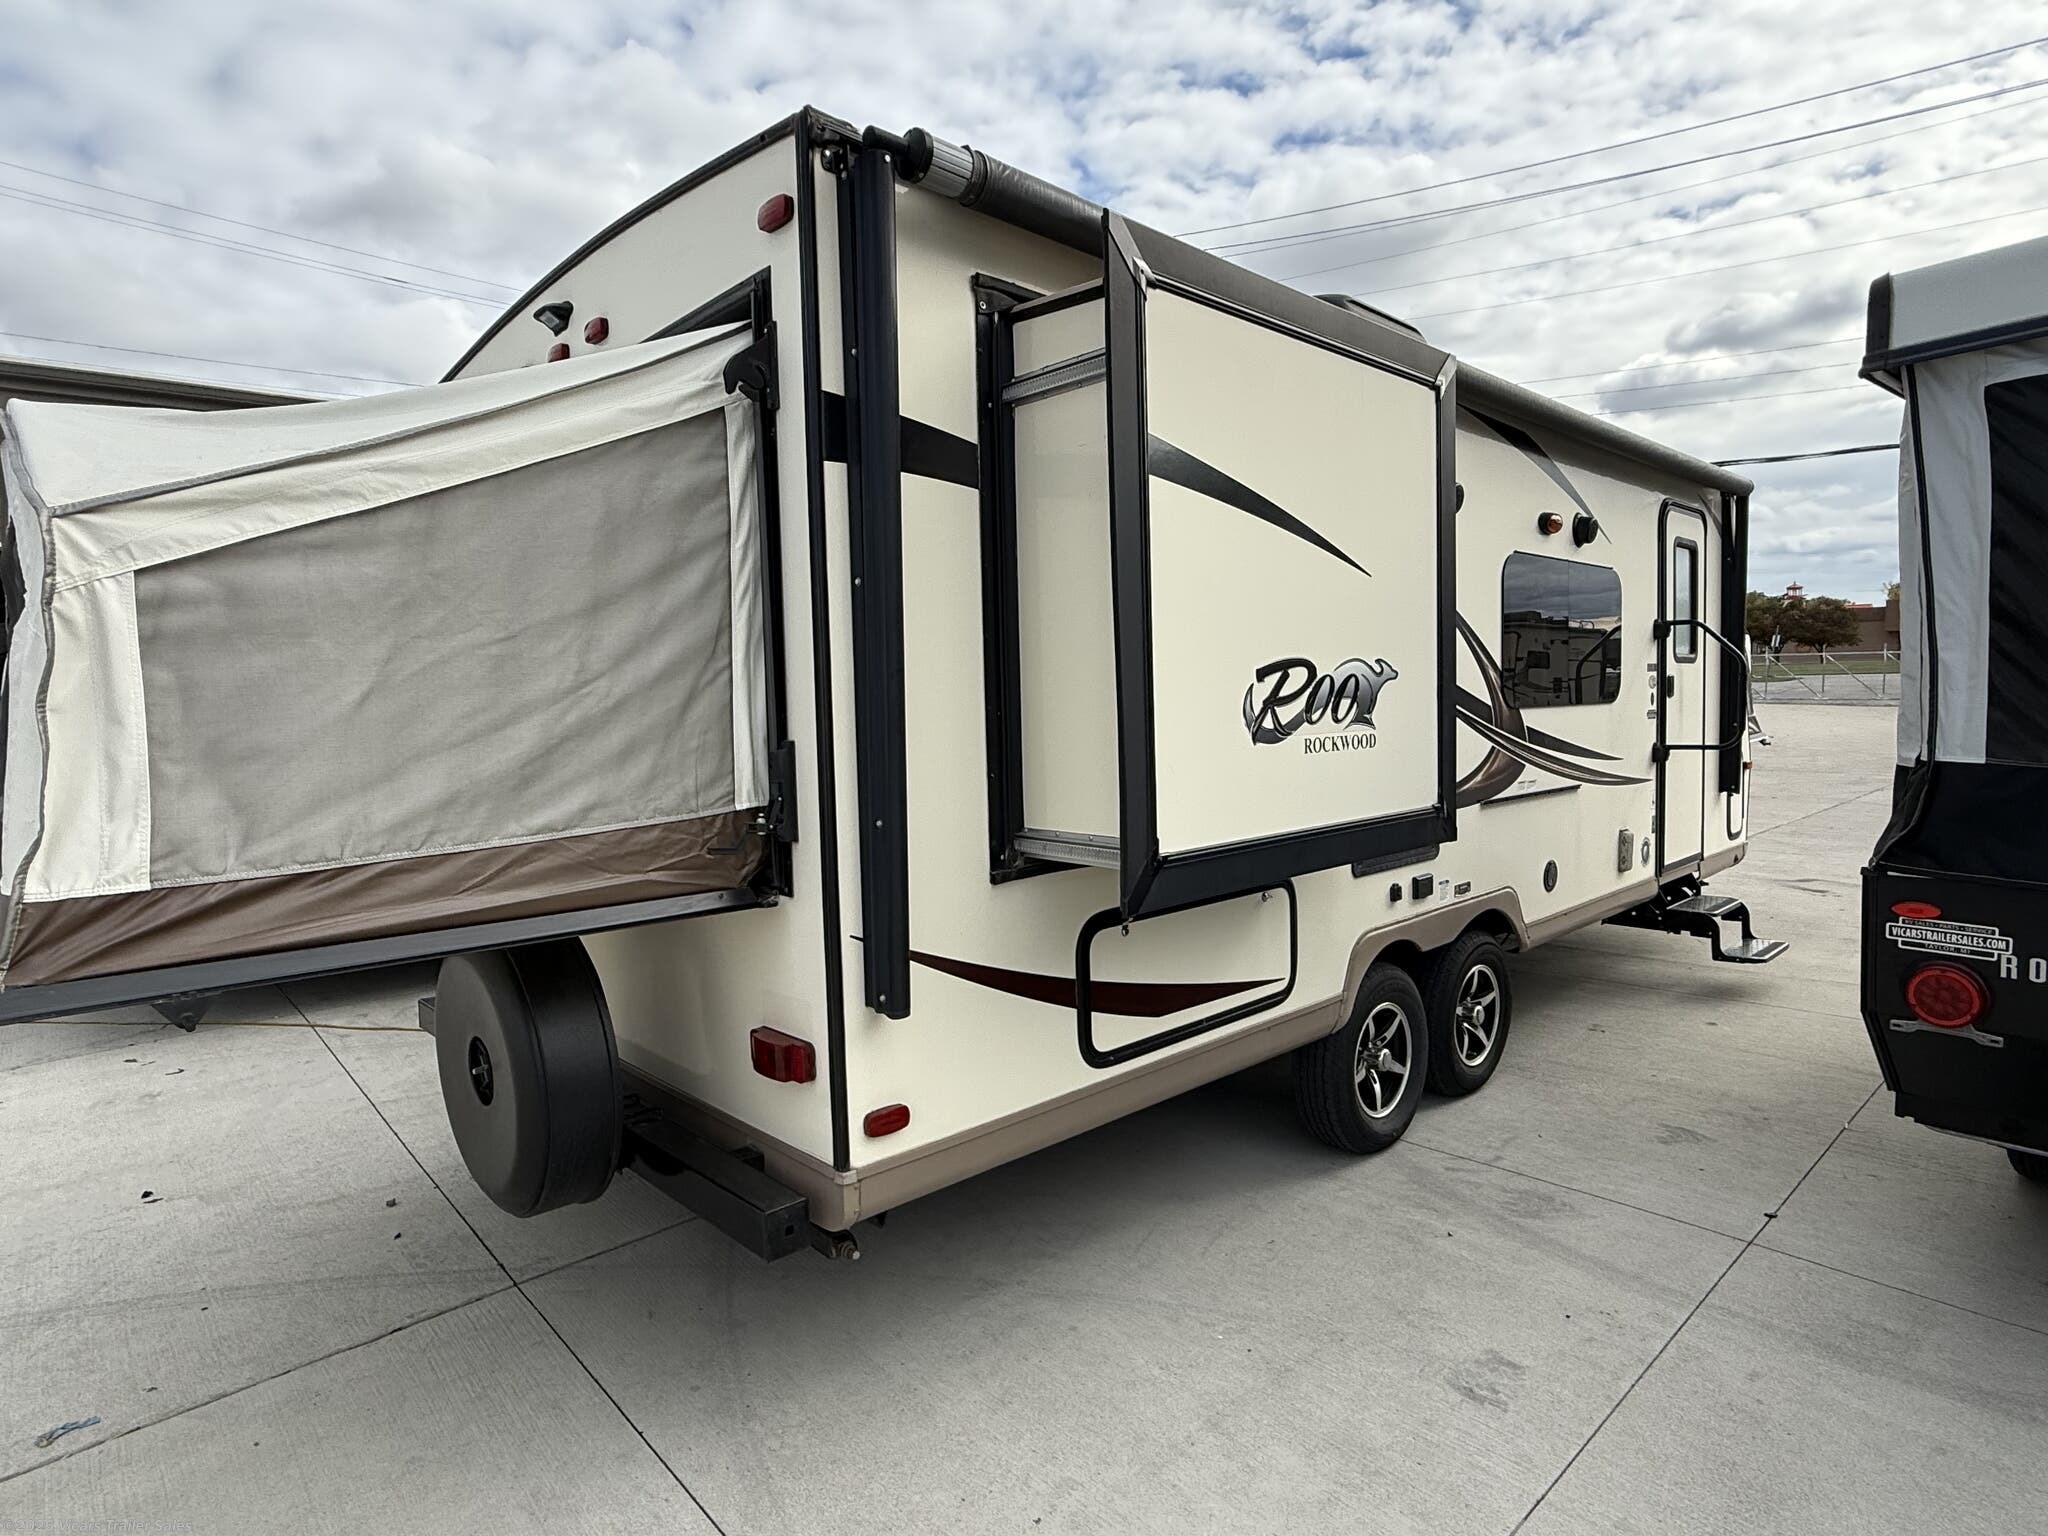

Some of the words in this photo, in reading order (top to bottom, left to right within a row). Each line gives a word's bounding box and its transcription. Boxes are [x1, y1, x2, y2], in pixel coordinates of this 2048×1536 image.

[1303, 733, 1377, 755] ROCKWOOD
[1891, 926, 2007, 951] VICARSTRAILERSALES.COM
[1914, 920, 1934, 928] SALES
[1938, 923, 1960, 931] PARTS
[1964, 926, 1993, 935] SERVICE
